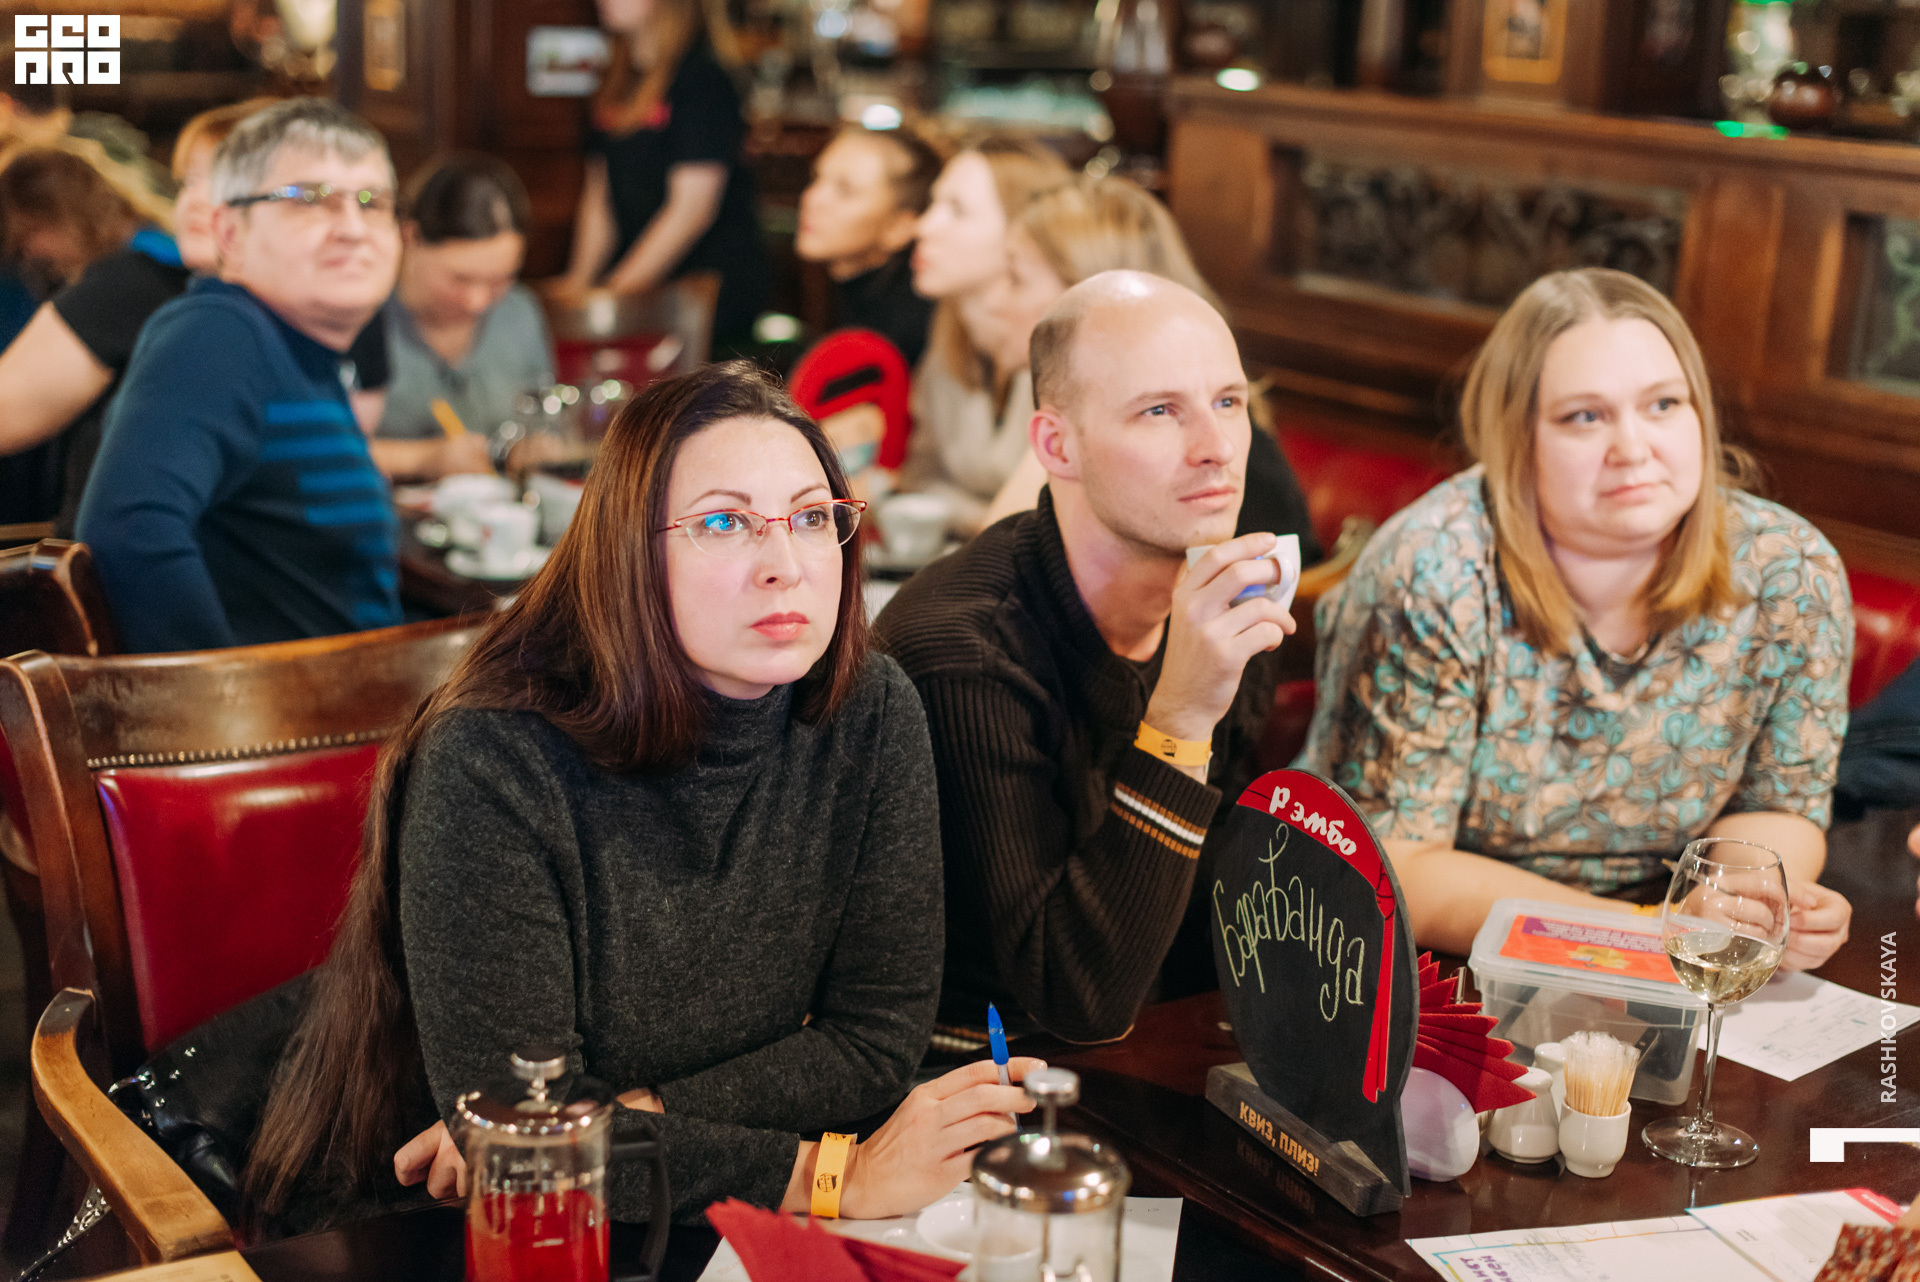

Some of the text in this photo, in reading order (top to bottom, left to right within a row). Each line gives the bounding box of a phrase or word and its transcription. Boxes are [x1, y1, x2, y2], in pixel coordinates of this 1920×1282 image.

[1269, 786, 1357, 856] Рэмбо
[1239, 1101, 1276, 1148] КВИЗ,
[1279, 1131, 1320, 1177] ПЛИЗ!
